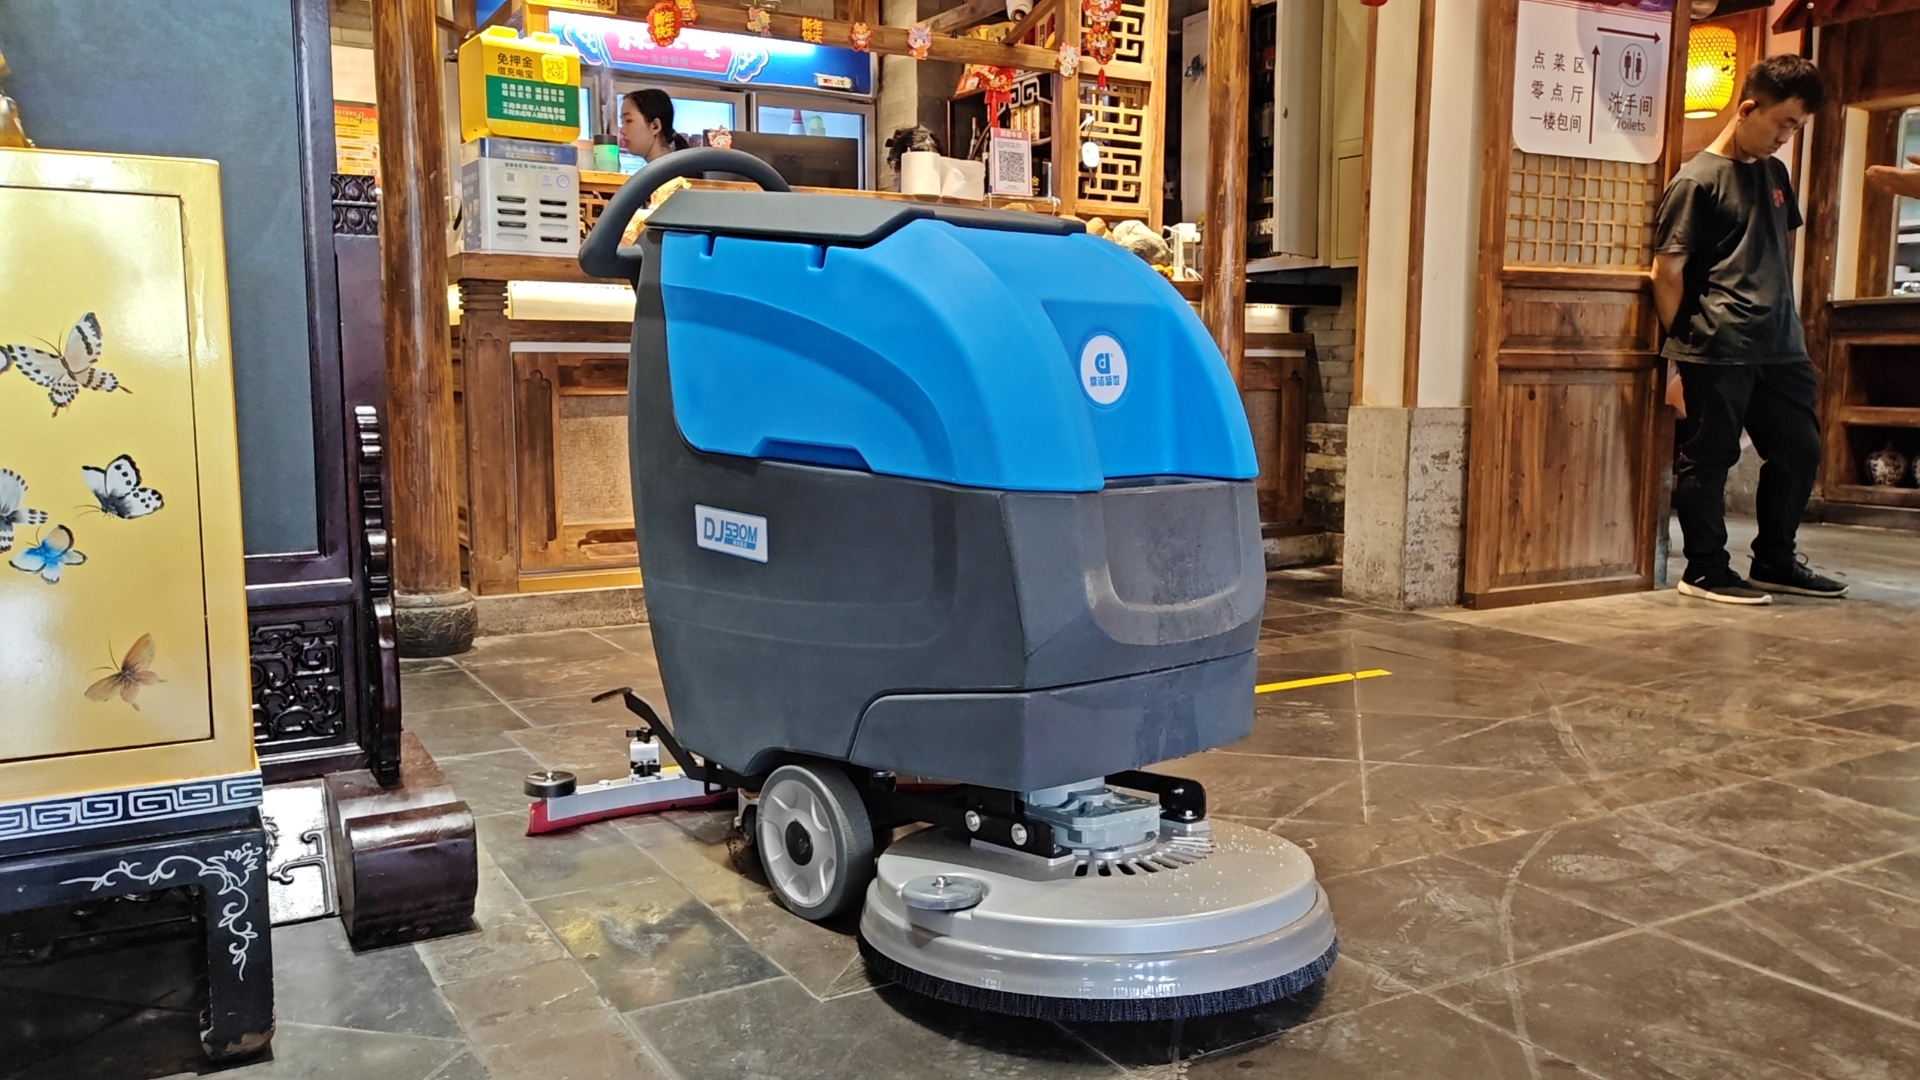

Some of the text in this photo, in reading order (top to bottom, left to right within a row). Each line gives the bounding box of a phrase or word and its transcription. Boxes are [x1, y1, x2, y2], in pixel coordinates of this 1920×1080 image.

[654, 11, 675, 26] 新年
[802, 17, 823, 31] 新年
[655, 23, 675, 39] 快乐
[802, 30, 823, 43] 快乐
[497, 52, 533, 69] 免押金
[1532, 50, 1585, 74] 点菜区
[497, 66, 534, 79] 借充电宝
[1531, 80, 1584, 104] 零点厅
[1608, 91, 1653, 117] 洗手间
[1529, 111, 1582, 133] 一楼包间
[1616, 116, 1646, 132] Toilets
[703, 516, 758, 543] DJ530M
